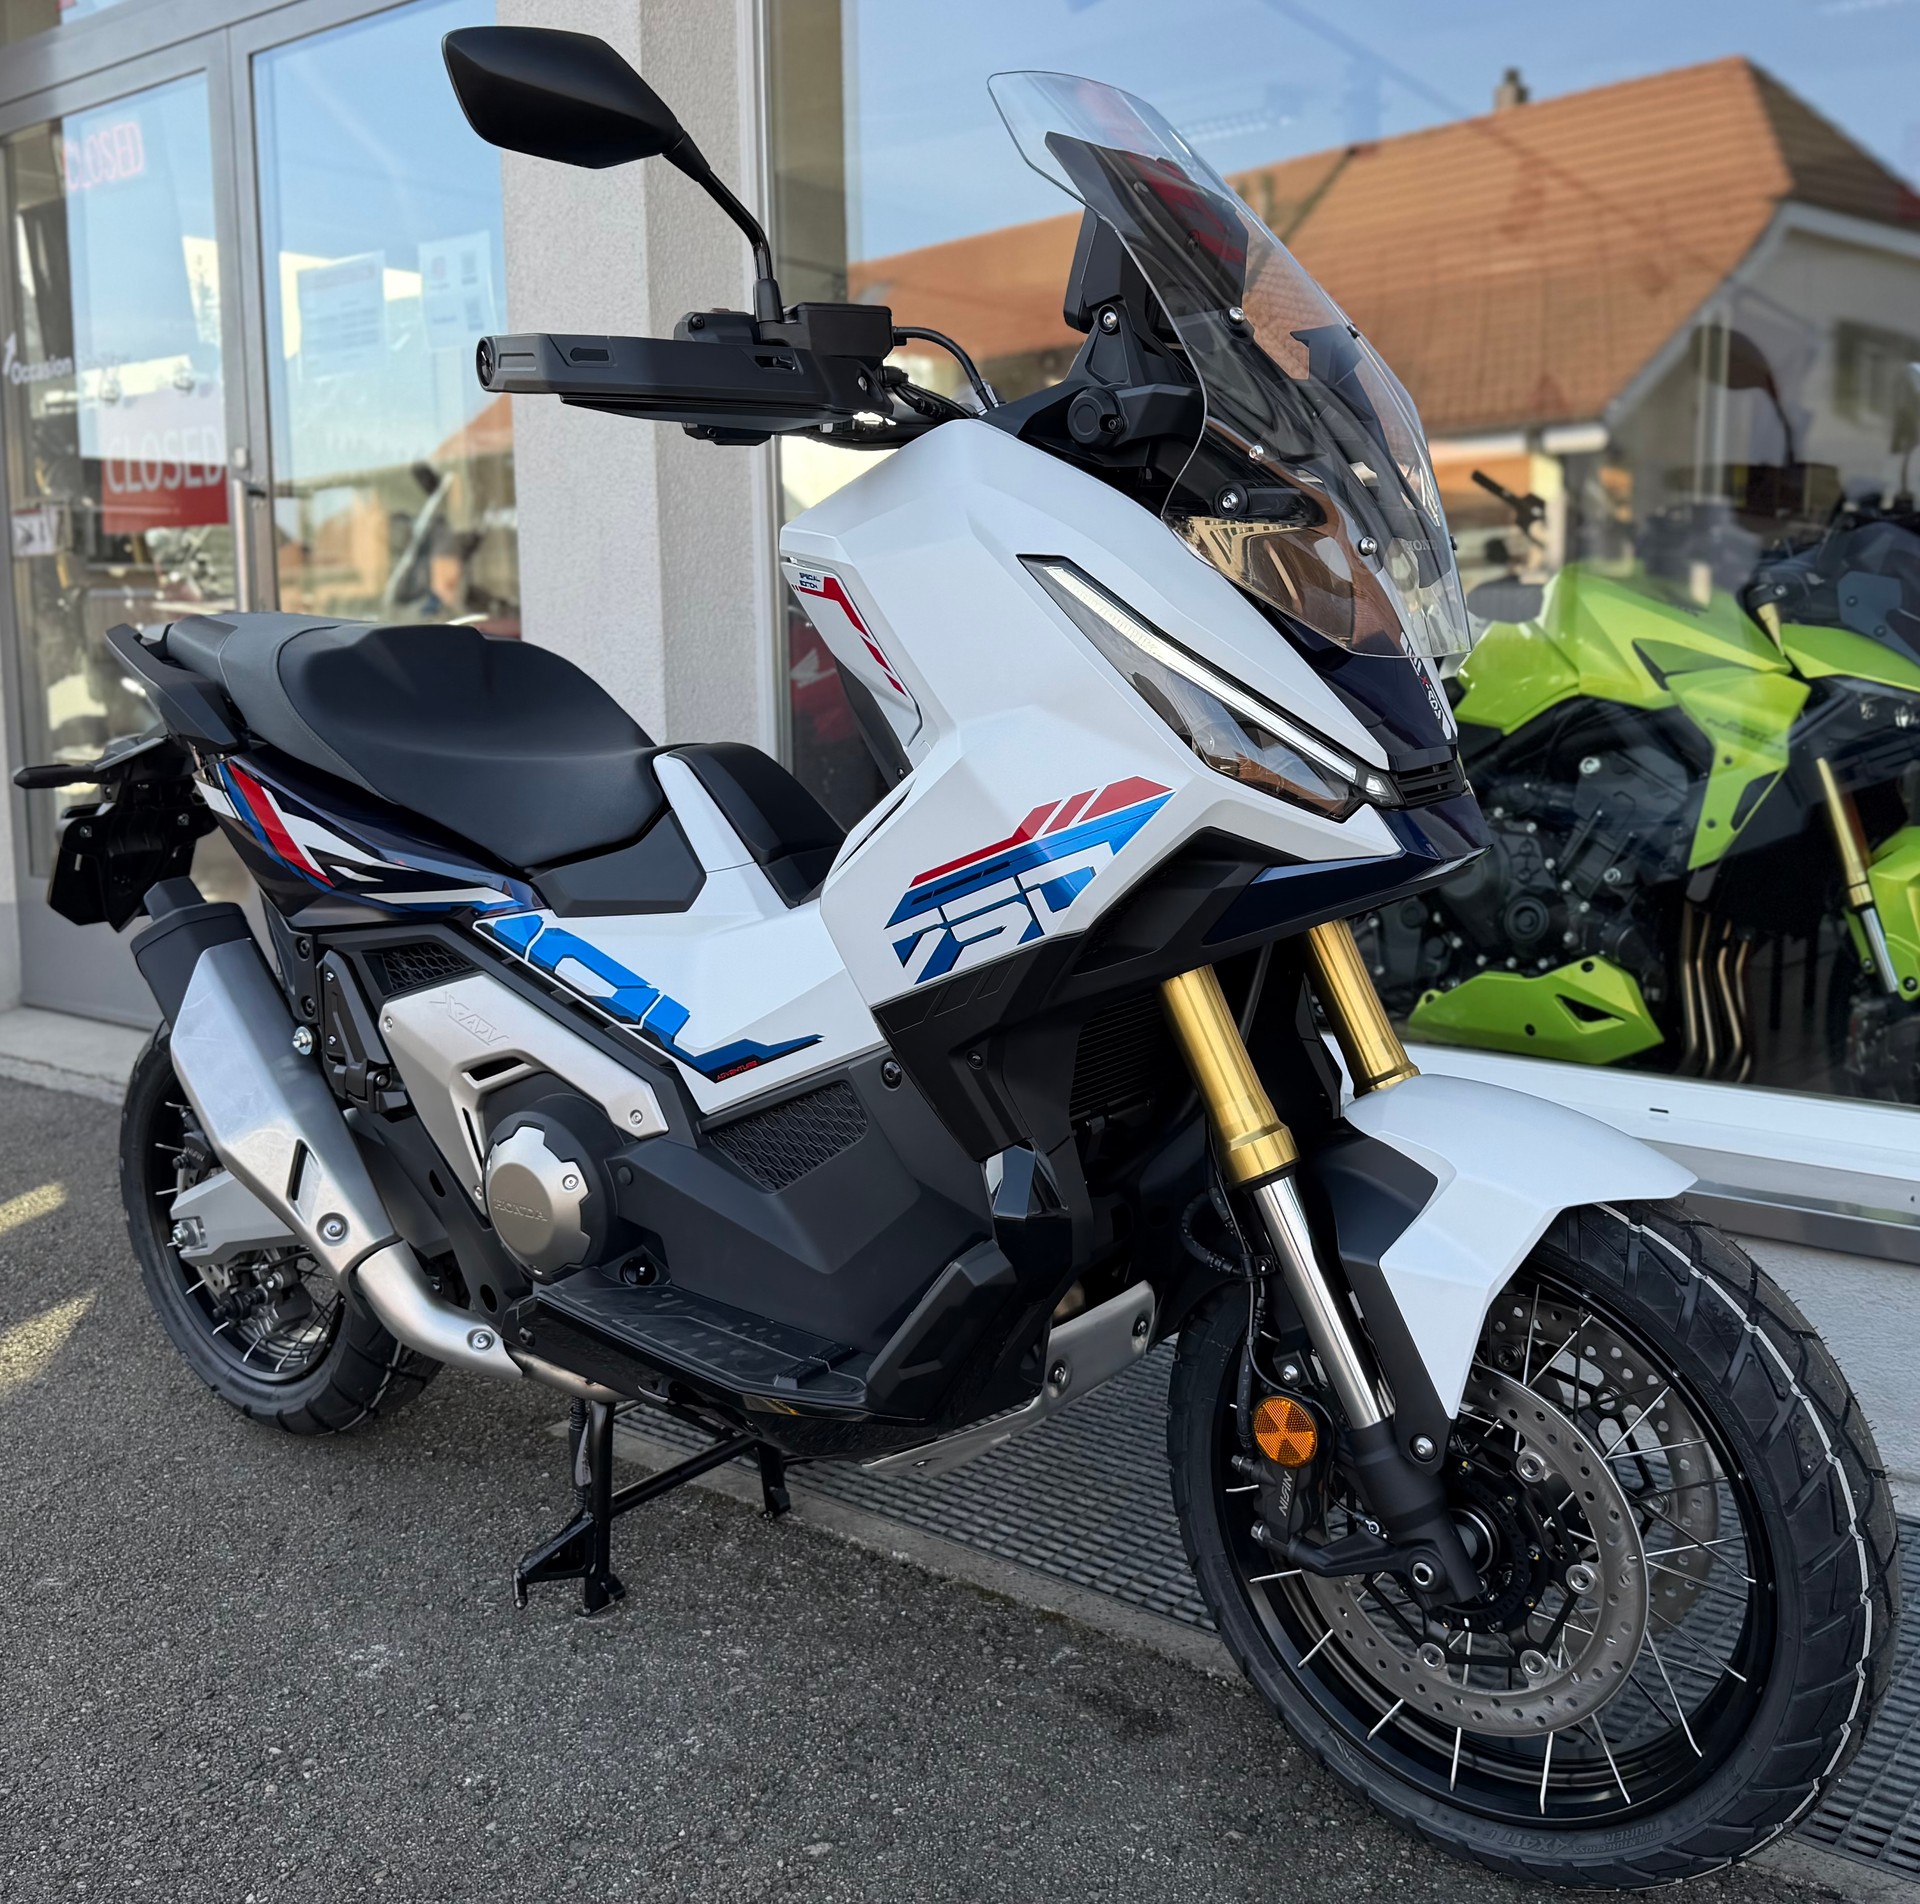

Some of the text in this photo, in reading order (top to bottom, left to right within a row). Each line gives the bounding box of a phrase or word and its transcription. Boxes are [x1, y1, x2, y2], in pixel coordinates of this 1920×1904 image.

[63, 120, 146, 193] CLOSED
[10, 355, 74, 386] Occasion
[105, 425, 224, 494] CLOSED
[1419, 674, 1441, 720] X-ADV
[429, 991, 510, 1046] X-ADV
[716, 1060, 759, 1081] ADVENTURE
[493, 1197, 549, 1222] HONDA
[1605, 1820, 1662, 1844] TOURER
